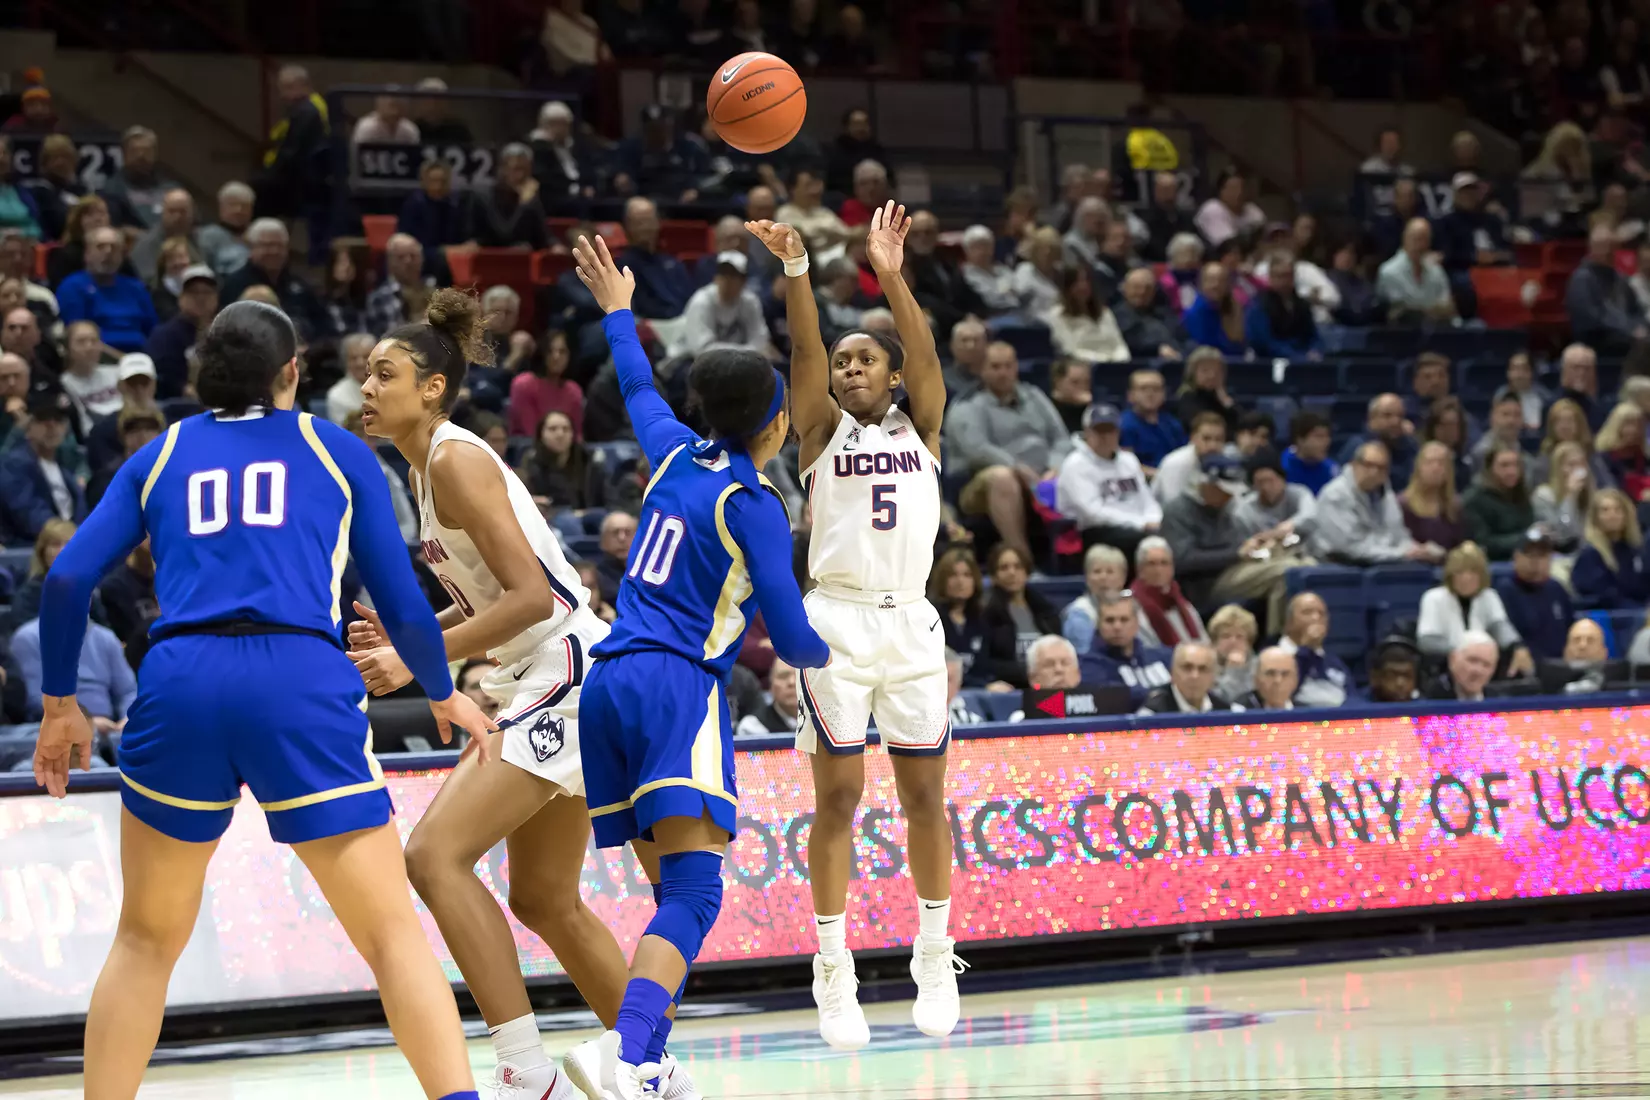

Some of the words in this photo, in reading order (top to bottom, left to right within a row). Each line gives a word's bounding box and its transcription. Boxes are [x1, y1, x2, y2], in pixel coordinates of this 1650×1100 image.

[741, 81, 776, 102] UCONN
[79, 144, 125, 191] 21
[833, 450, 923, 478] UCONN
[187, 459, 288, 537] 00
[871, 483, 897, 531] 5
[627, 509, 686, 588] 10
[1073, 776, 1402, 863] COMPANY
[1431, 772, 1509, 837] OF
[1530, 765, 1650, 831] UCO
